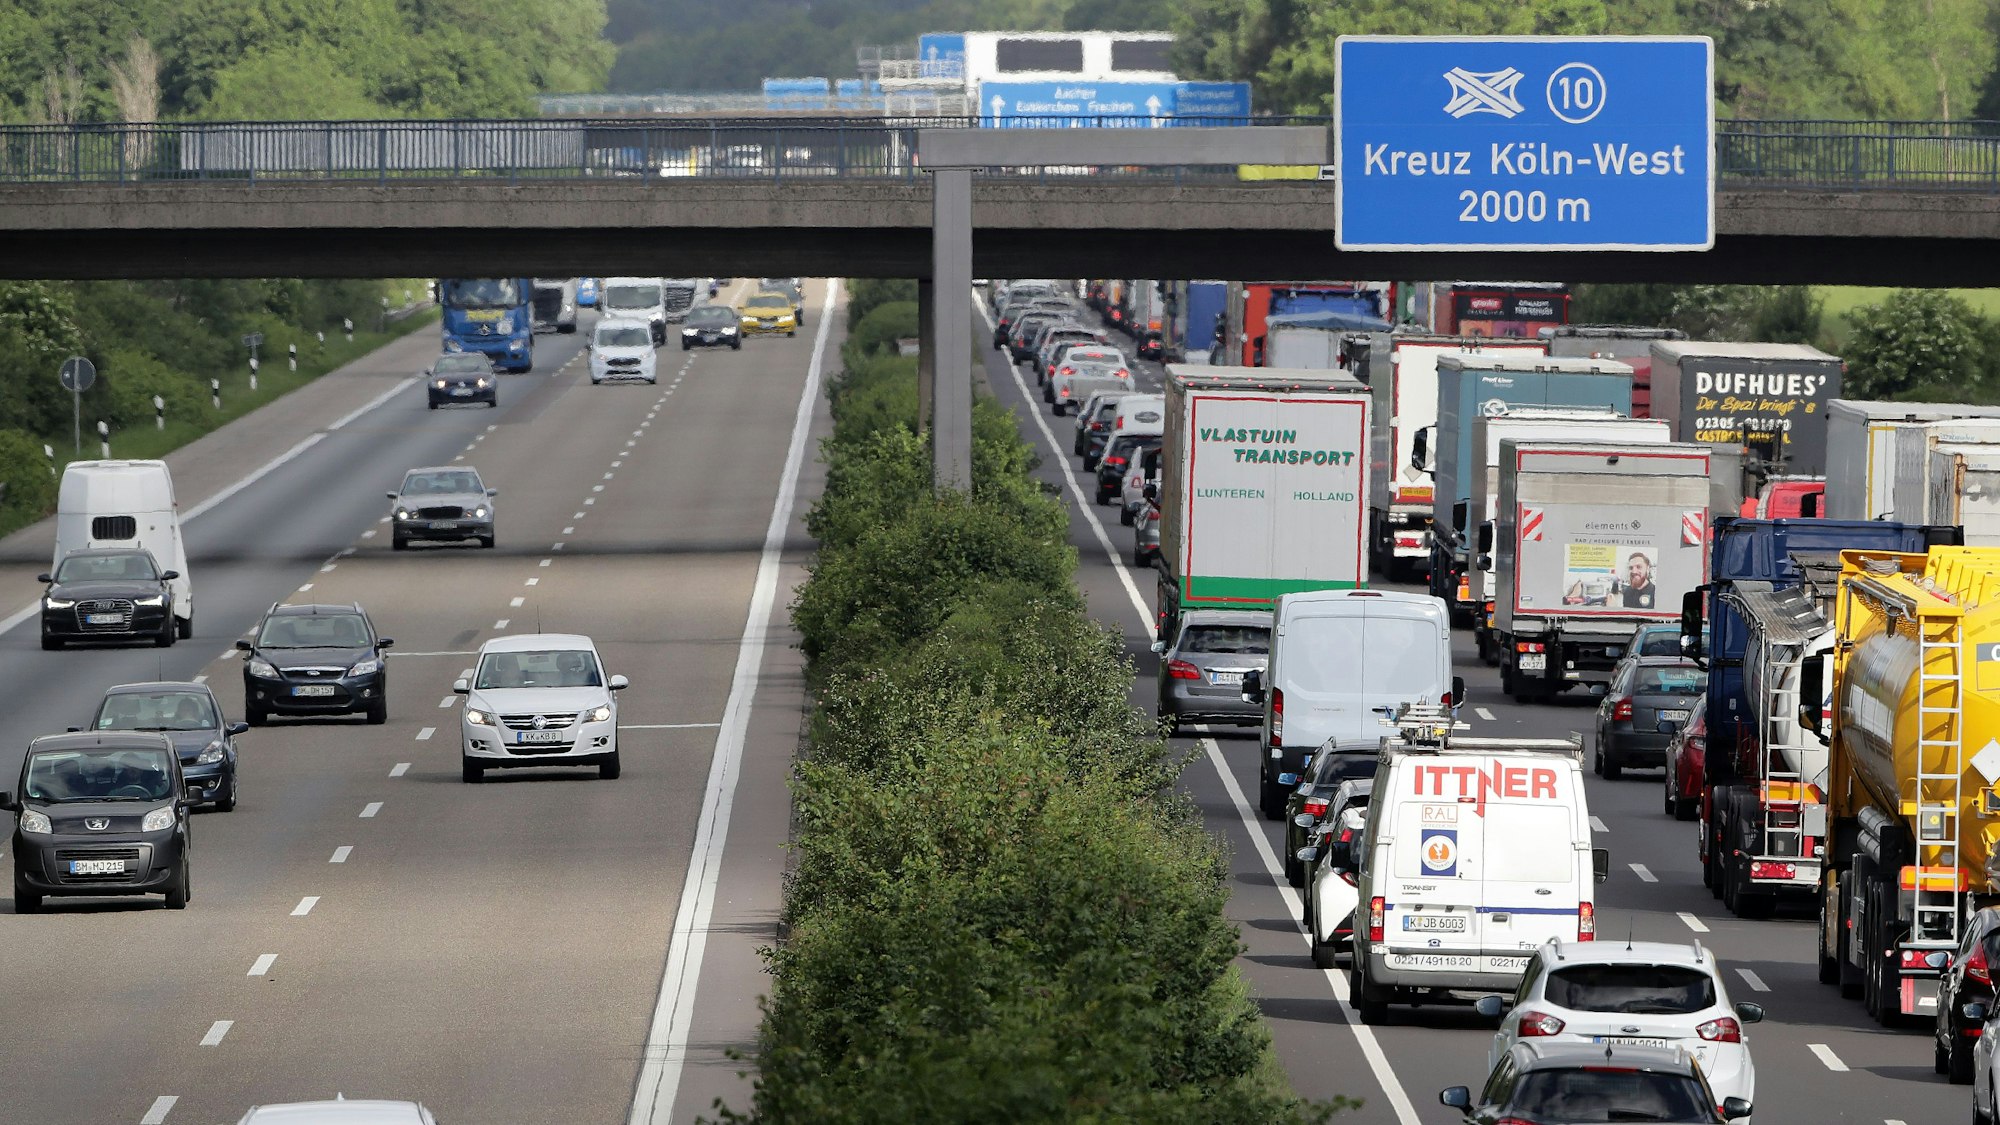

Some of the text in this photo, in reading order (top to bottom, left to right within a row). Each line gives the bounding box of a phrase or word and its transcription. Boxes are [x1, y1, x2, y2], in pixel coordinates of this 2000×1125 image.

[1559, 77, 1593, 110] 10
[1364, 142, 1686, 176] Kreuz Köln-West
[1458, 190, 1591, 222] 2000 m
[1696, 397, 1717, 411] Der
[1720, 396, 1756, 414] Spezi
[1757, 399, 1796, 416] bringt
[1695, 416, 1735, 430] 02305
[1200, 428, 1297, 444] VLASTUIN
[1233, 449, 1354, 466] TRANSPORT
[1197, 489, 1354, 502] LUNTEREN HOLLAND
[1585, 520, 1628, 530] elements
[1414, 759, 1557, 818] ITTNER
[1424, 807, 1456, 820] RAL
[106, 862, 124, 871] 215
[1409, 918, 1464, 929] K JB 6003
[1518, 942, 1538, 951] Fax
